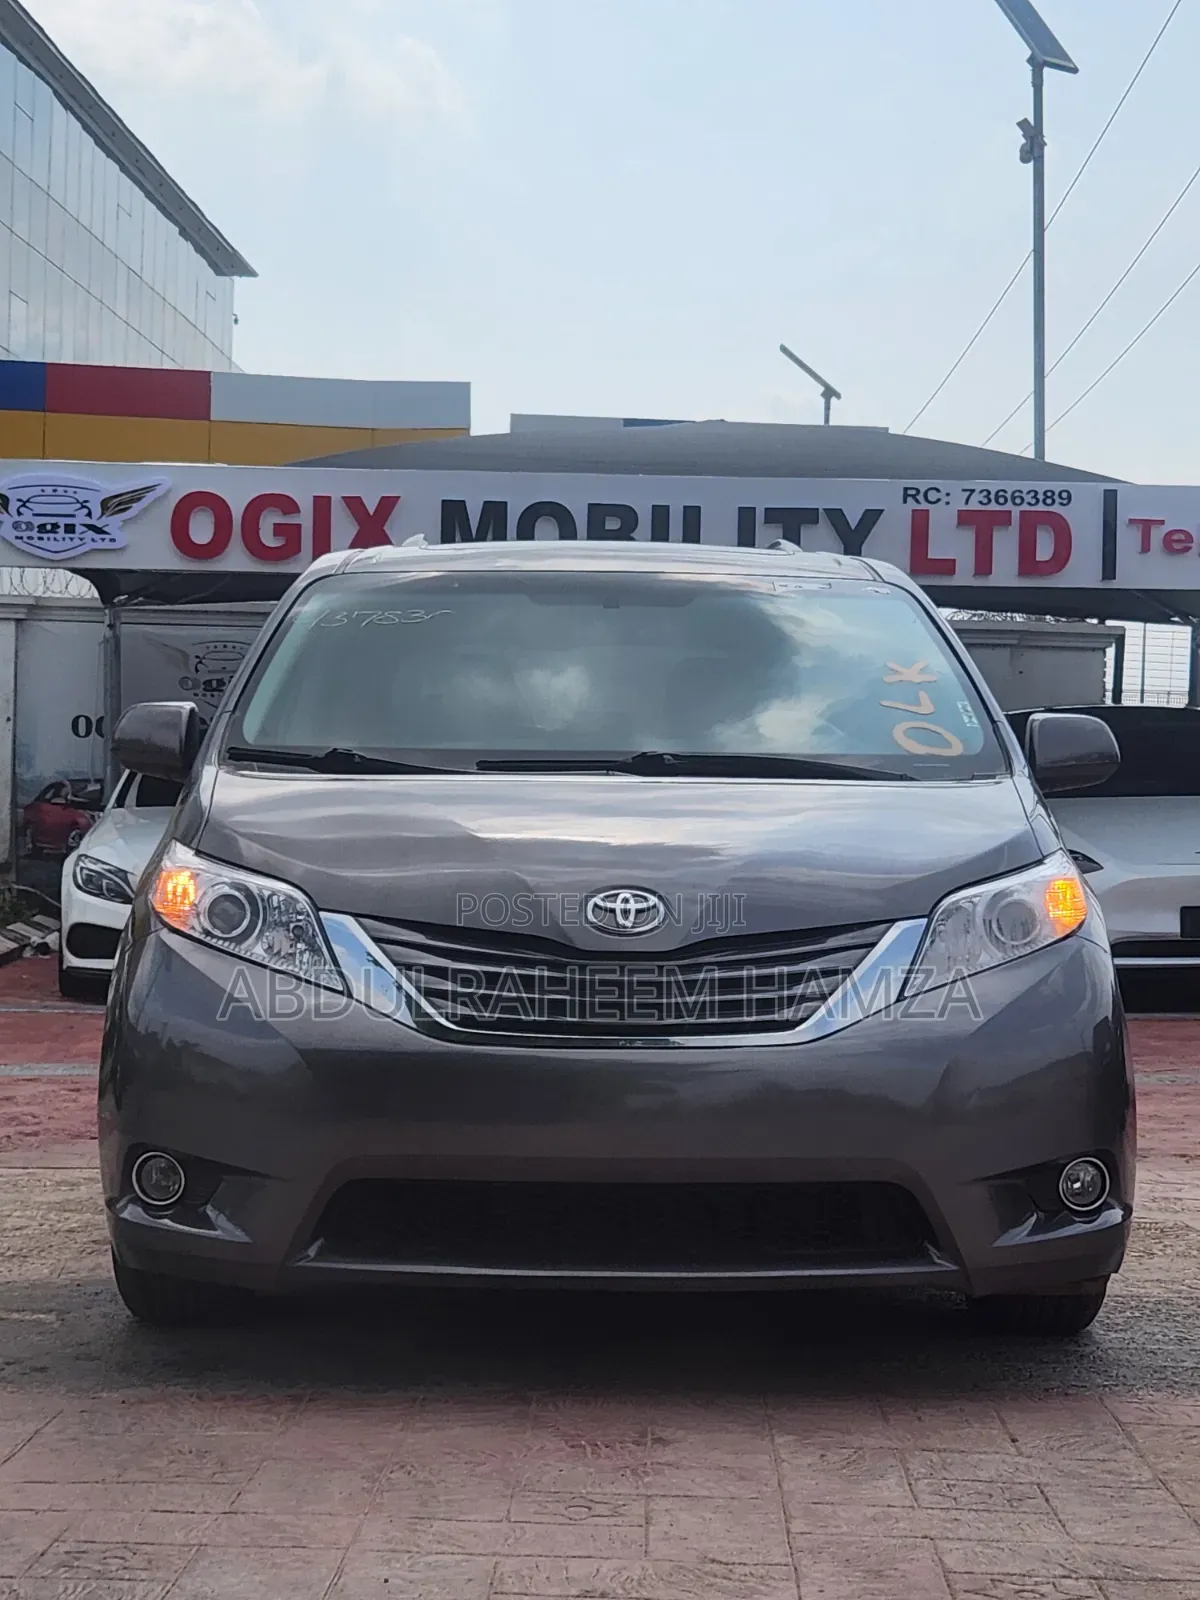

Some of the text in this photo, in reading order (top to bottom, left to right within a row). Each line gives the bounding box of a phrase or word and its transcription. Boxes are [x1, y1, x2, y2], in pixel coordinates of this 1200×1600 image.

[902, 486, 1073, 507] RC: 7366389
[14, 534, 86, 543] MOBILITY
[170, 490, 401, 562] OGIX
[909, 508, 1073, 577] LTD
[1127, 518, 1199, 555] Te
